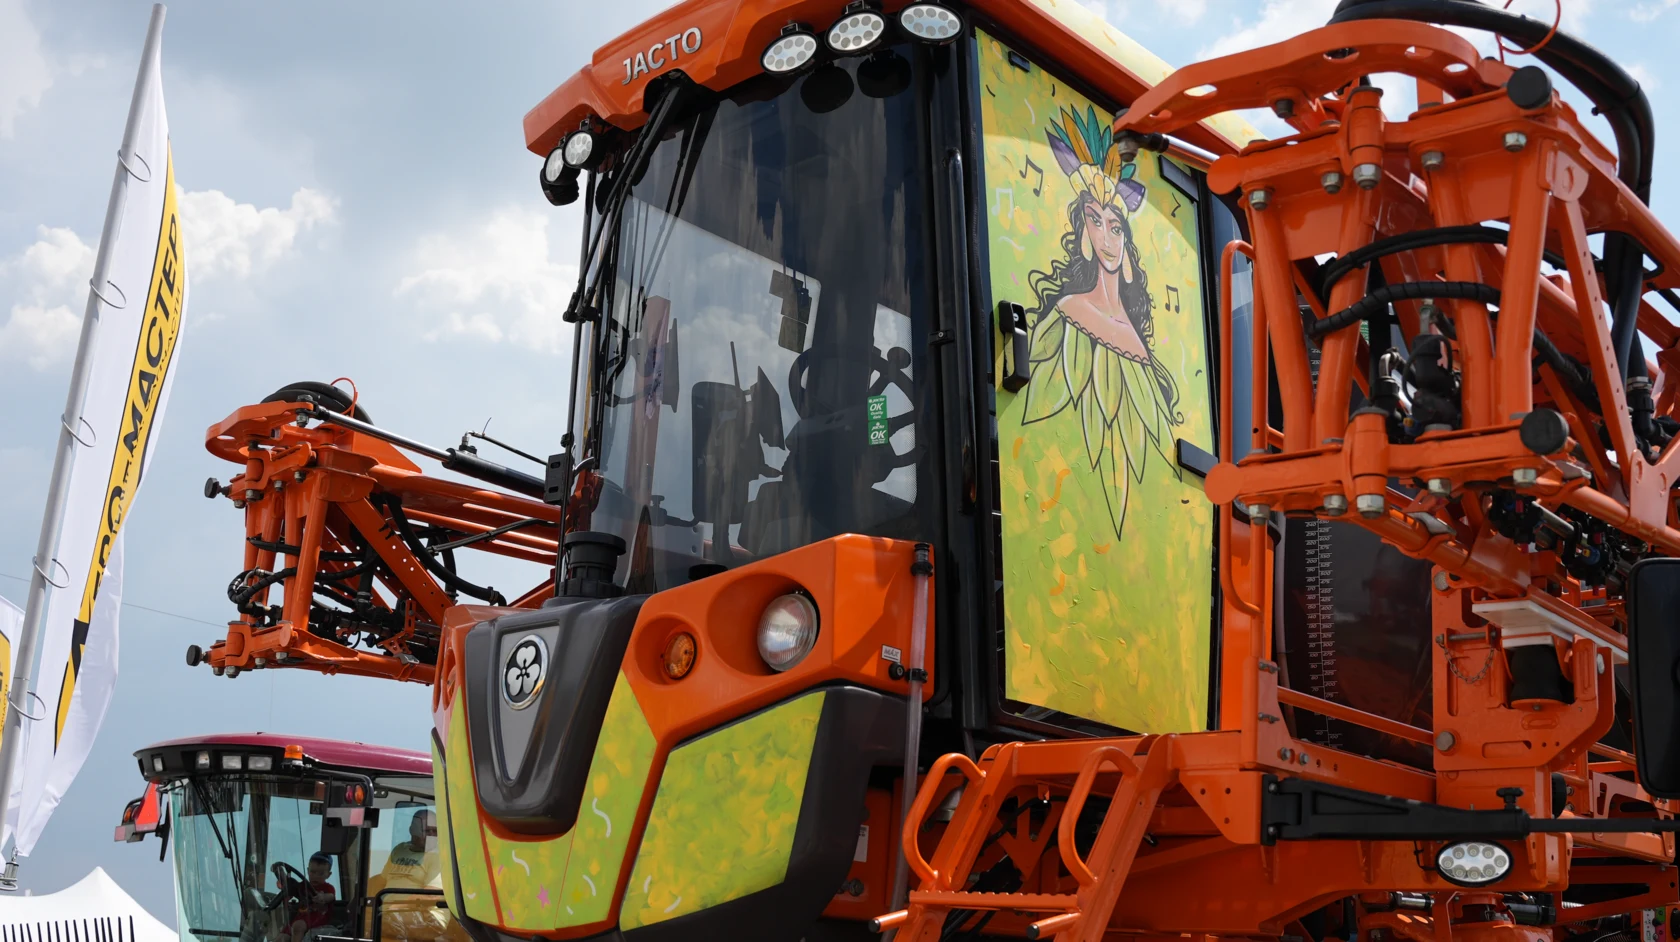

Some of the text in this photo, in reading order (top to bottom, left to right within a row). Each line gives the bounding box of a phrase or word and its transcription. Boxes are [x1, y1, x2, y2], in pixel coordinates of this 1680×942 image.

[622, 27, 702, 85] JACTO
[870, 403, 884, 411] OK
[870, 430, 886, 440] OK
